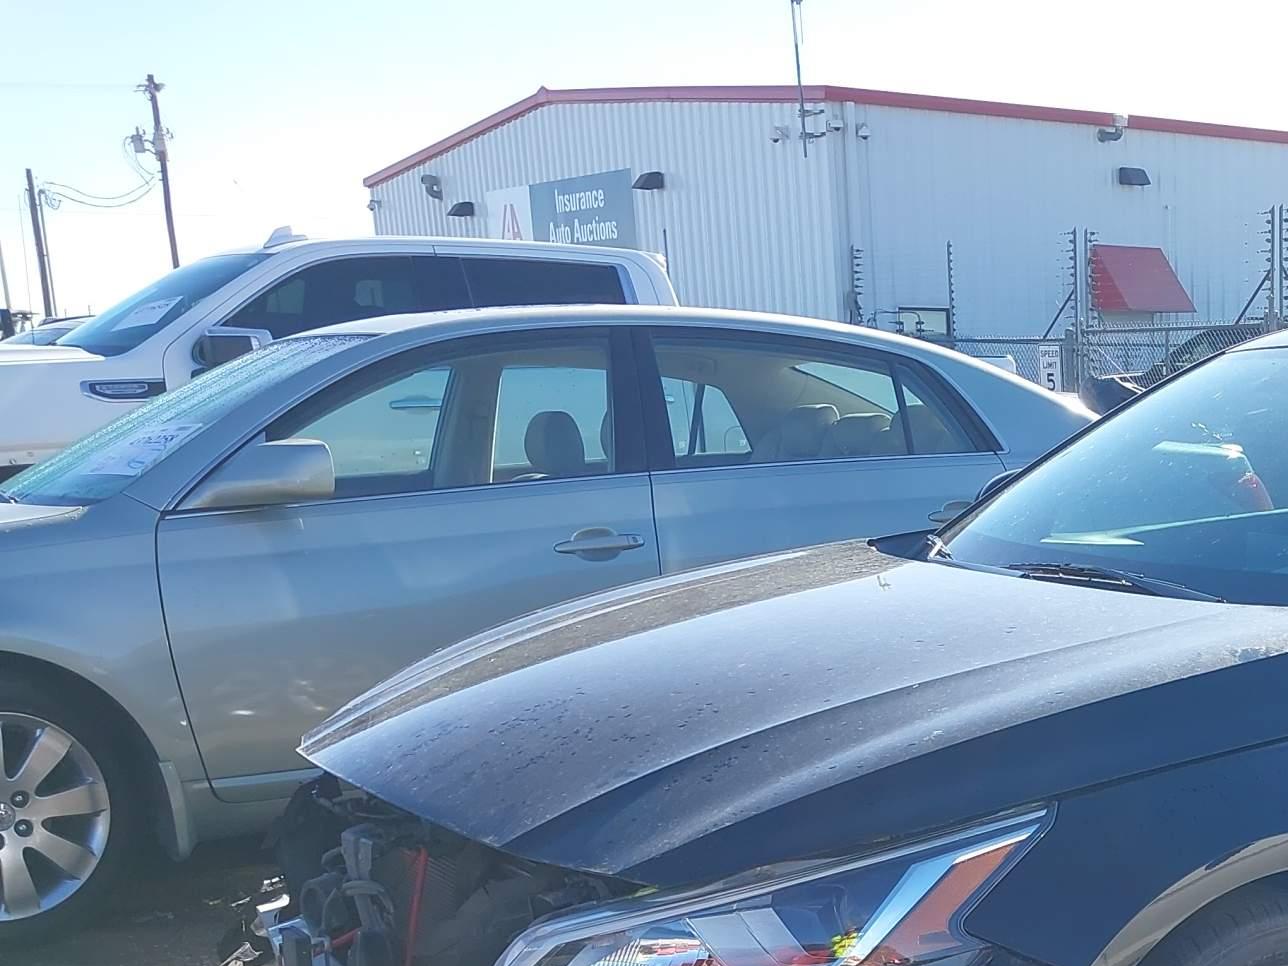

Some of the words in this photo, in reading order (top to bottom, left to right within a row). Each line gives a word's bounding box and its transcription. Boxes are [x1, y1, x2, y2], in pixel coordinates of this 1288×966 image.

[554, 188, 605, 214] Insurance
[549, 221, 572, 244] Auto
[574, 215, 618, 243] Auctions
[1040, 350, 1059, 358] SPEED
[1046, 372, 1056, 391] 5
